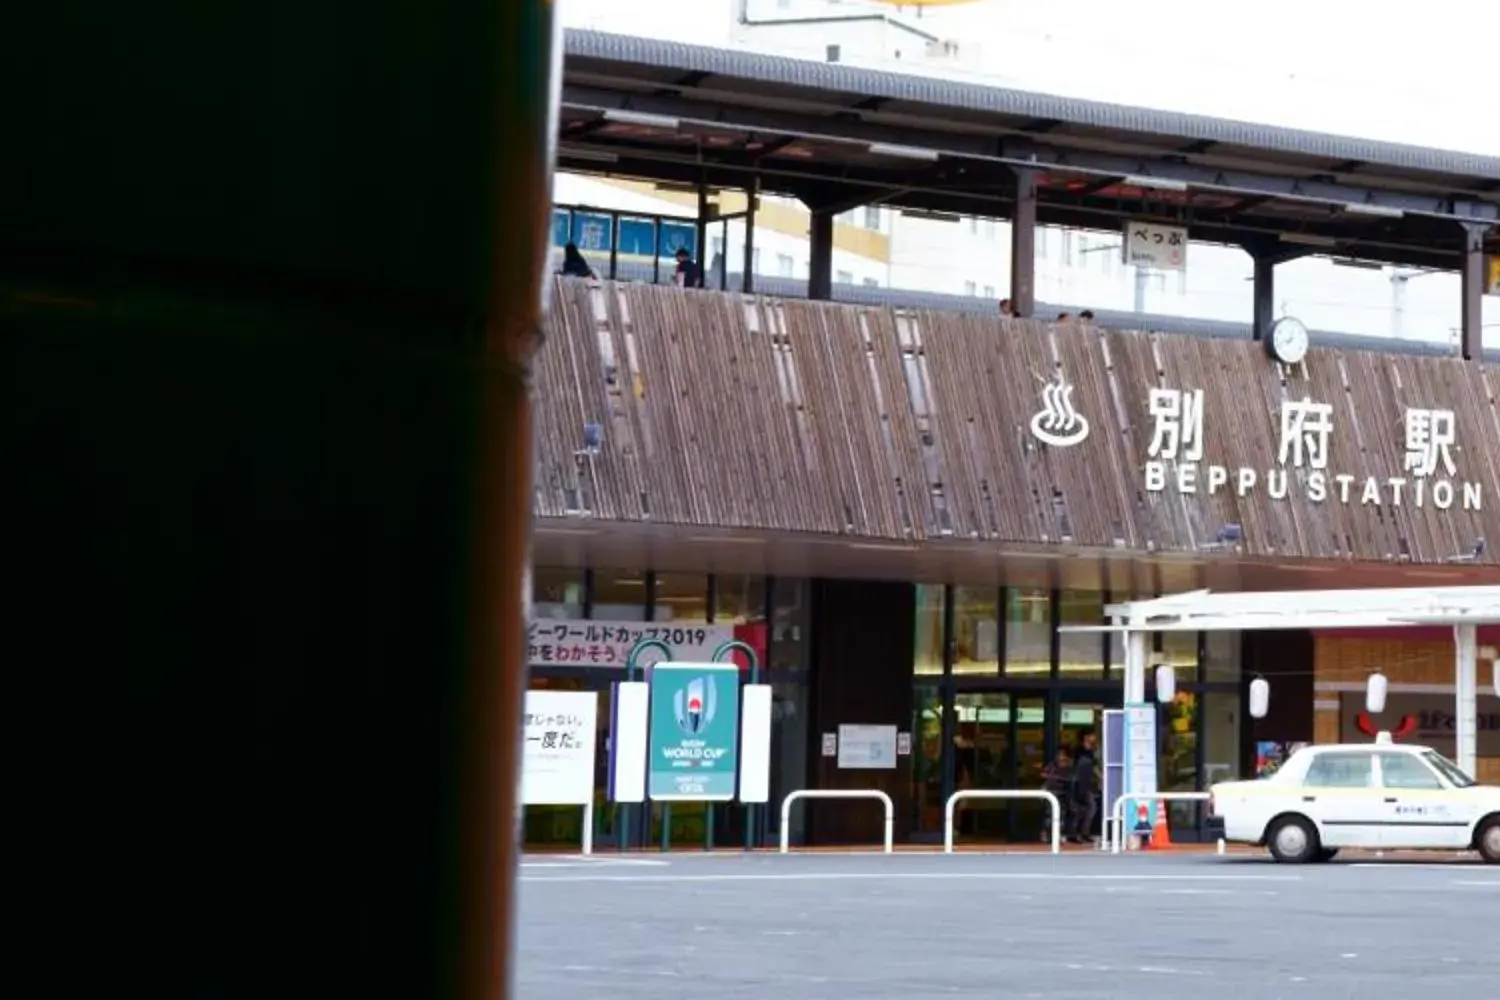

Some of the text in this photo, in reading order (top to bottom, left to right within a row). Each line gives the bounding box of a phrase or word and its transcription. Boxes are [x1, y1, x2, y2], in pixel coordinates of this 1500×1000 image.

[1147, 387, 1458, 477] 別府駅
[1145, 461, 1482, 510] BEPPU STATION
